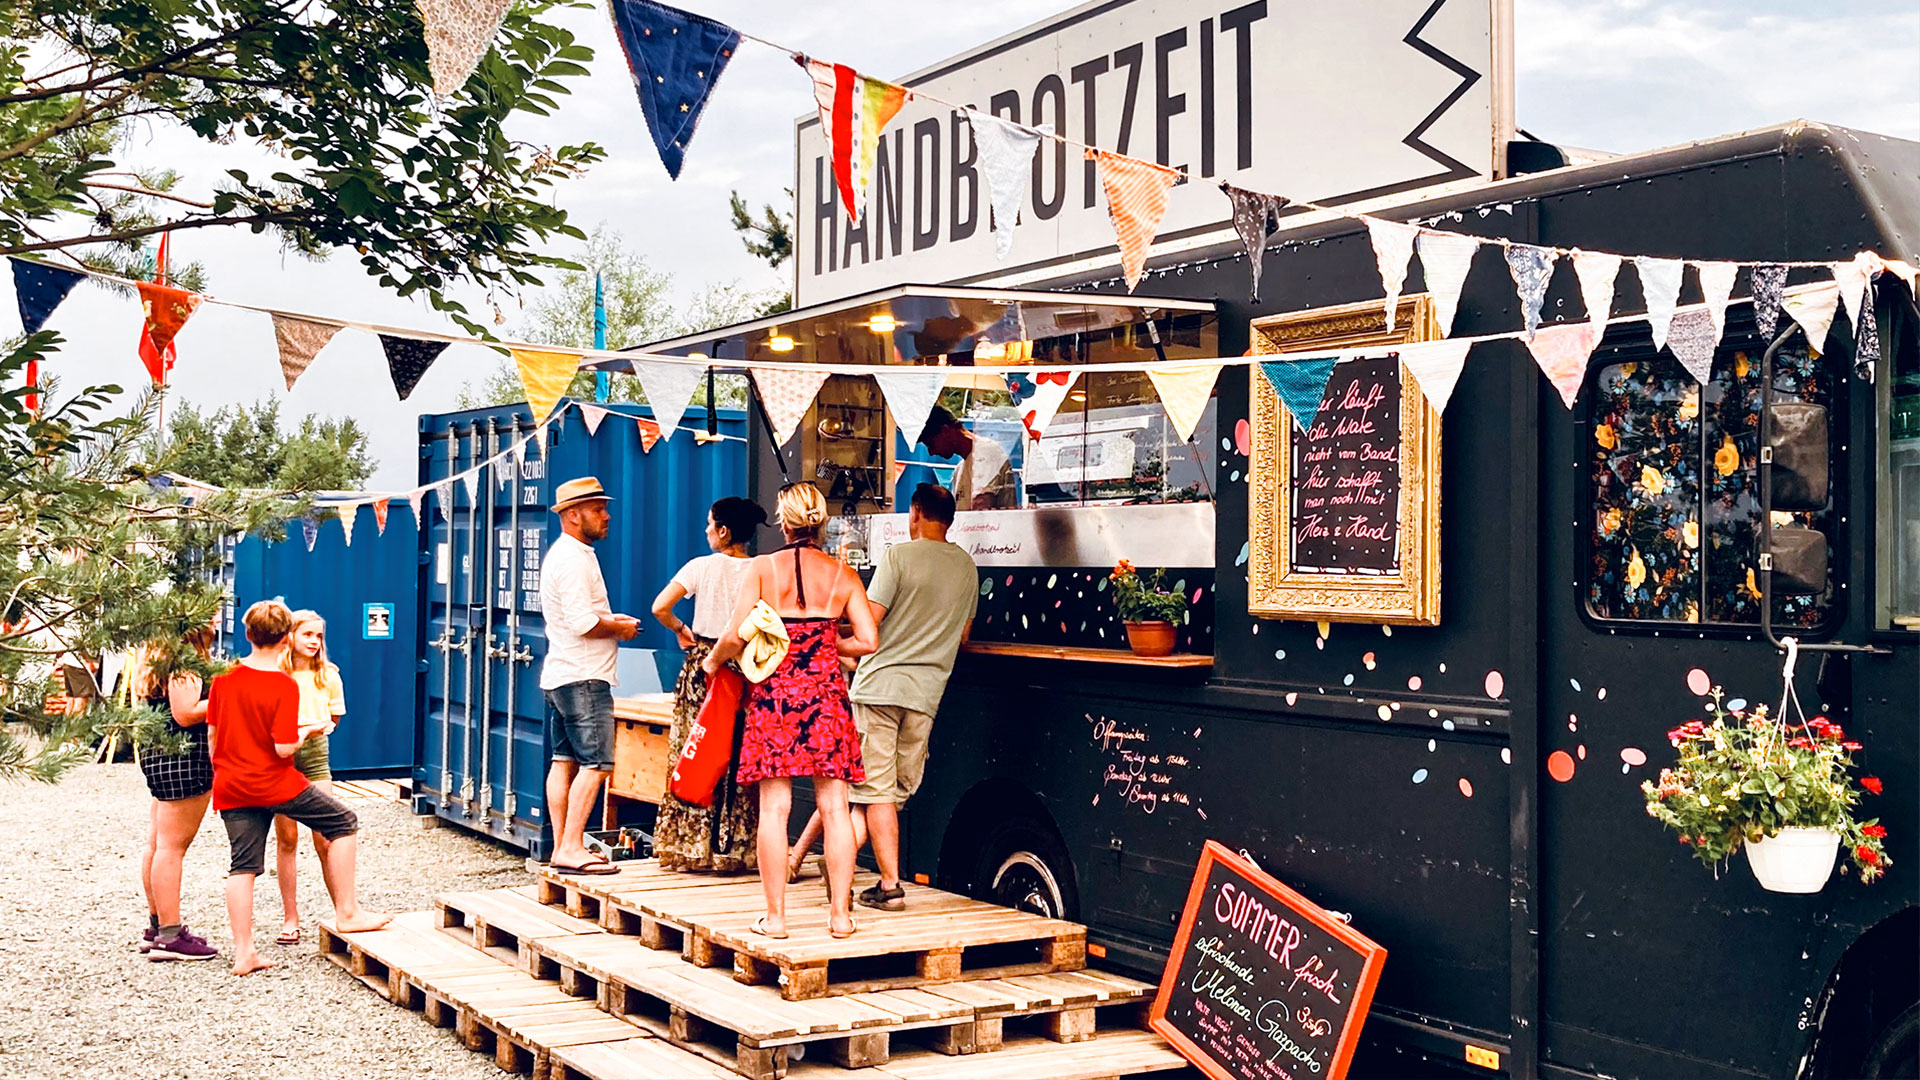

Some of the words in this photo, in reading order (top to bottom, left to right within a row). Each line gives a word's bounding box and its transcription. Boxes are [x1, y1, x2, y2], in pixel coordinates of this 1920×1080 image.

[1309, 424, 1329, 441] die
[1331, 416, 1375, 438] Ware
[1304, 446, 1332, 462] nicht
[1338, 450, 1356, 459] vom
[1302, 464, 1331, 490] hier
[1334, 470, 1383, 503] schafft
[1304, 497, 1325, 508] man
[1330, 491, 1353, 505] noch
[1363, 490, 1386, 505] mit
[1298, 513, 1330, 544] Herz
[1345, 514, 1392, 541] Hand
[1214, 882, 1301, 970] SOMMER
[1287, 954, 1341, 1005] frisch
[1191, 969, 1251, 1022] Melonen
[1256, 999, 1321, 1073] Gazpacho
